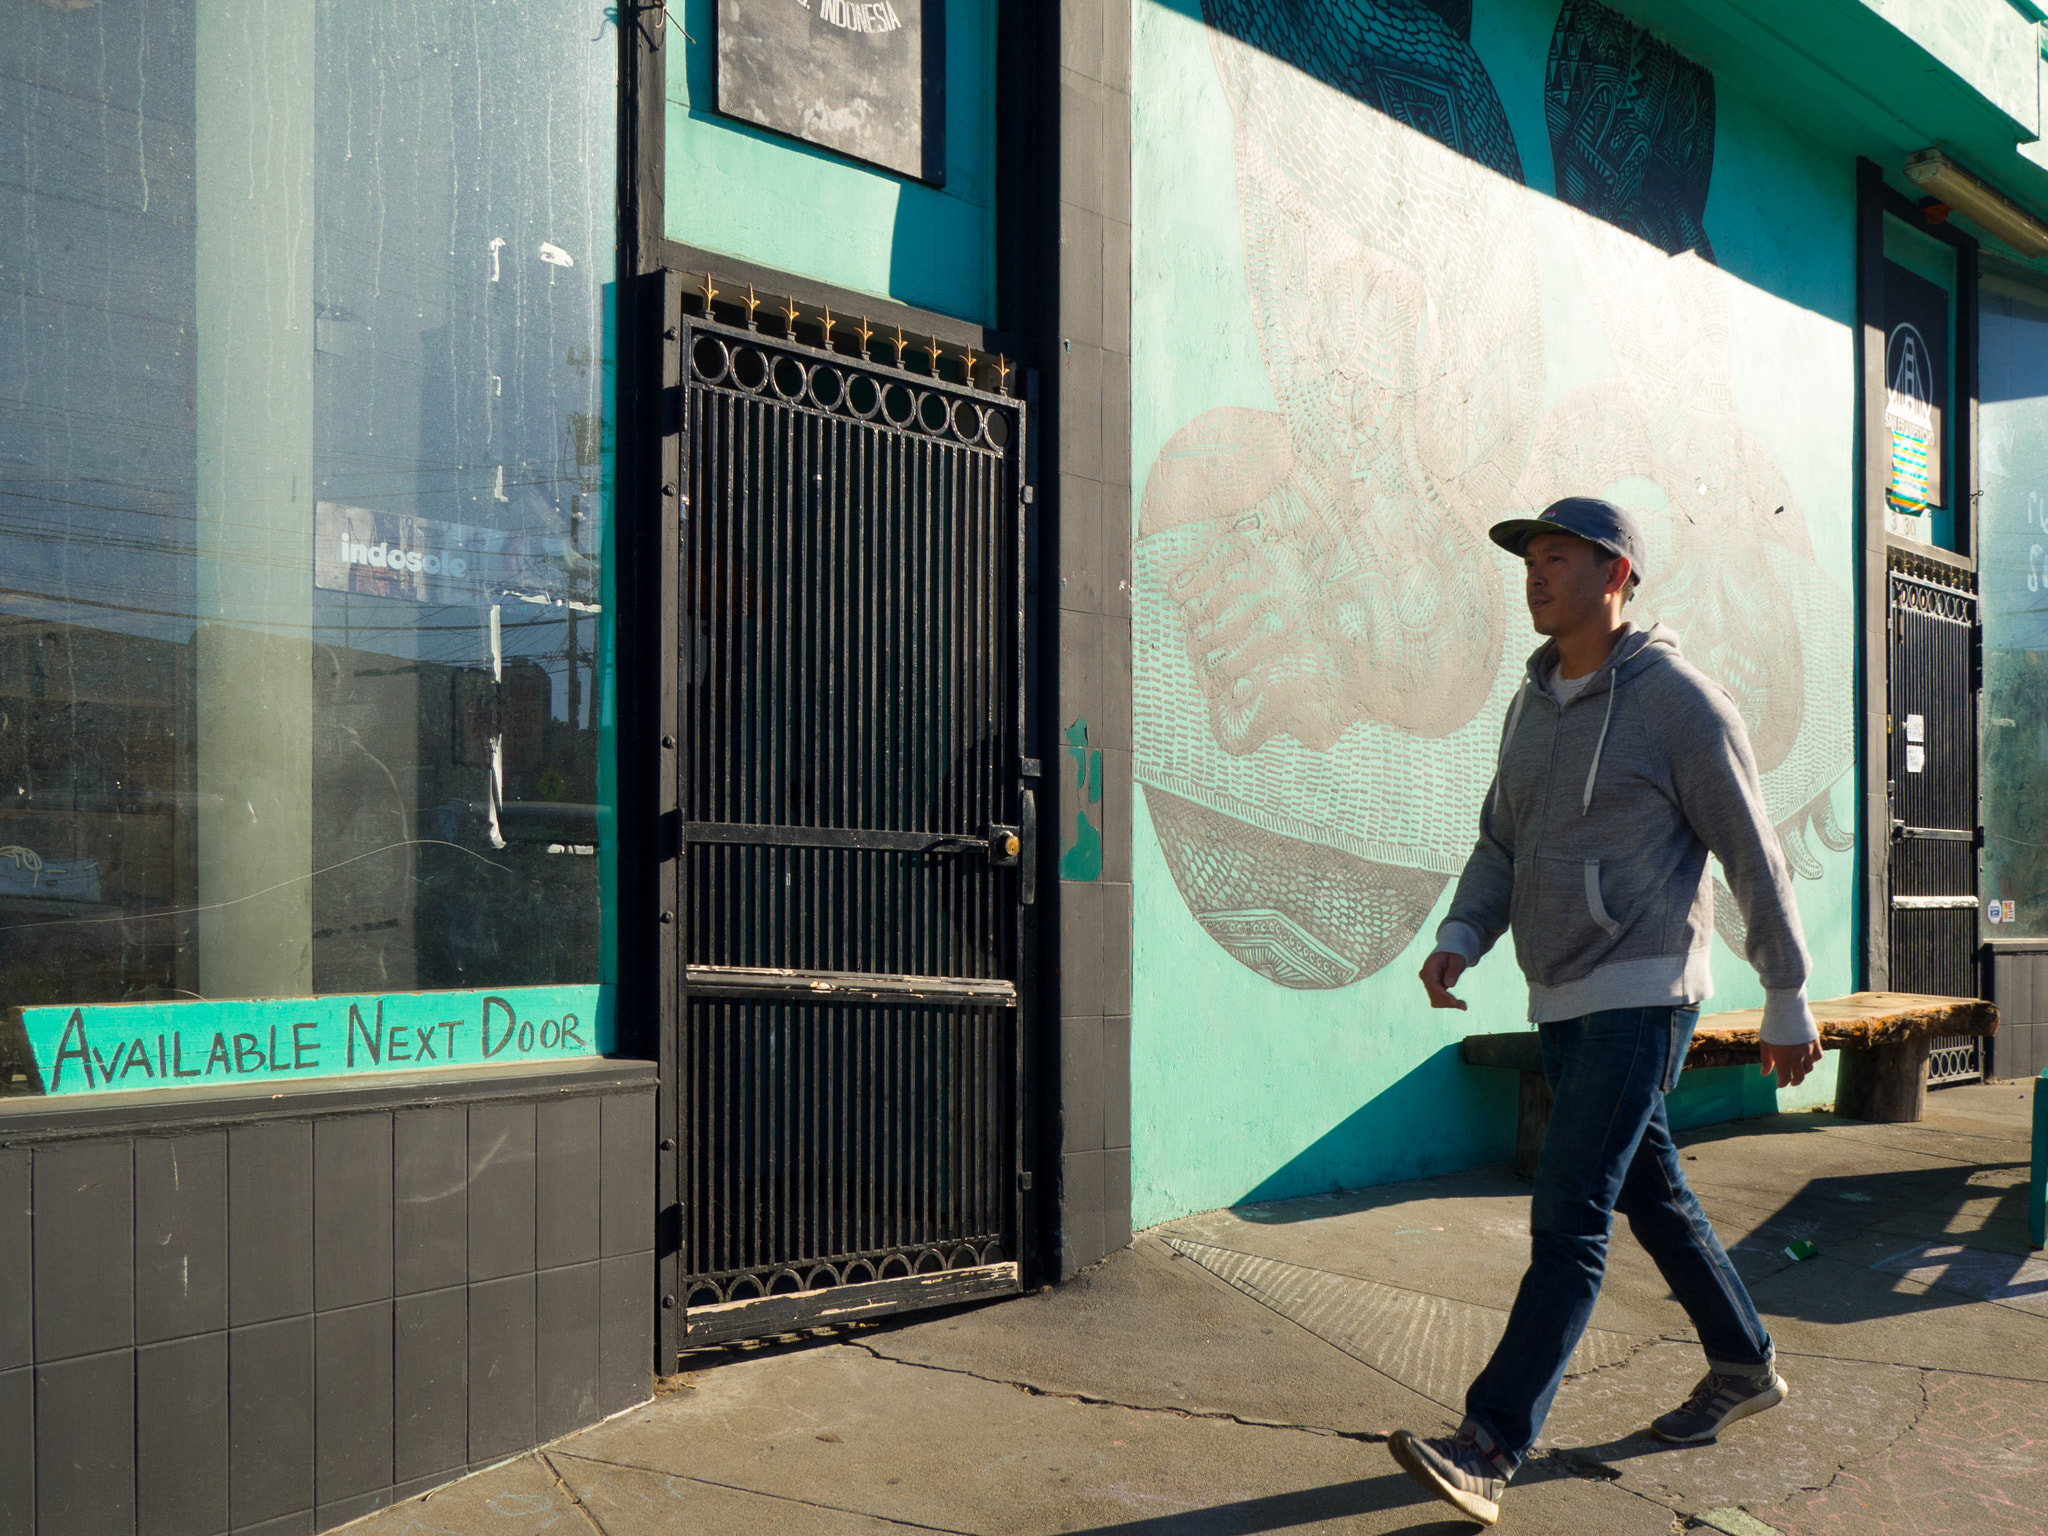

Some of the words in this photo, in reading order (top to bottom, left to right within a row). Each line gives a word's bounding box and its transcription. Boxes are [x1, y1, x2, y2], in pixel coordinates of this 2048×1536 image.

[820, 0, 902, 33] INDONESIA
[340, 532, 467, 578] indosole
[51, 1007, 321, 1093] AVAILABLE
[347, 1000, 465, 1069] NEXT
[481, 996, 587, 1059] DOOR
